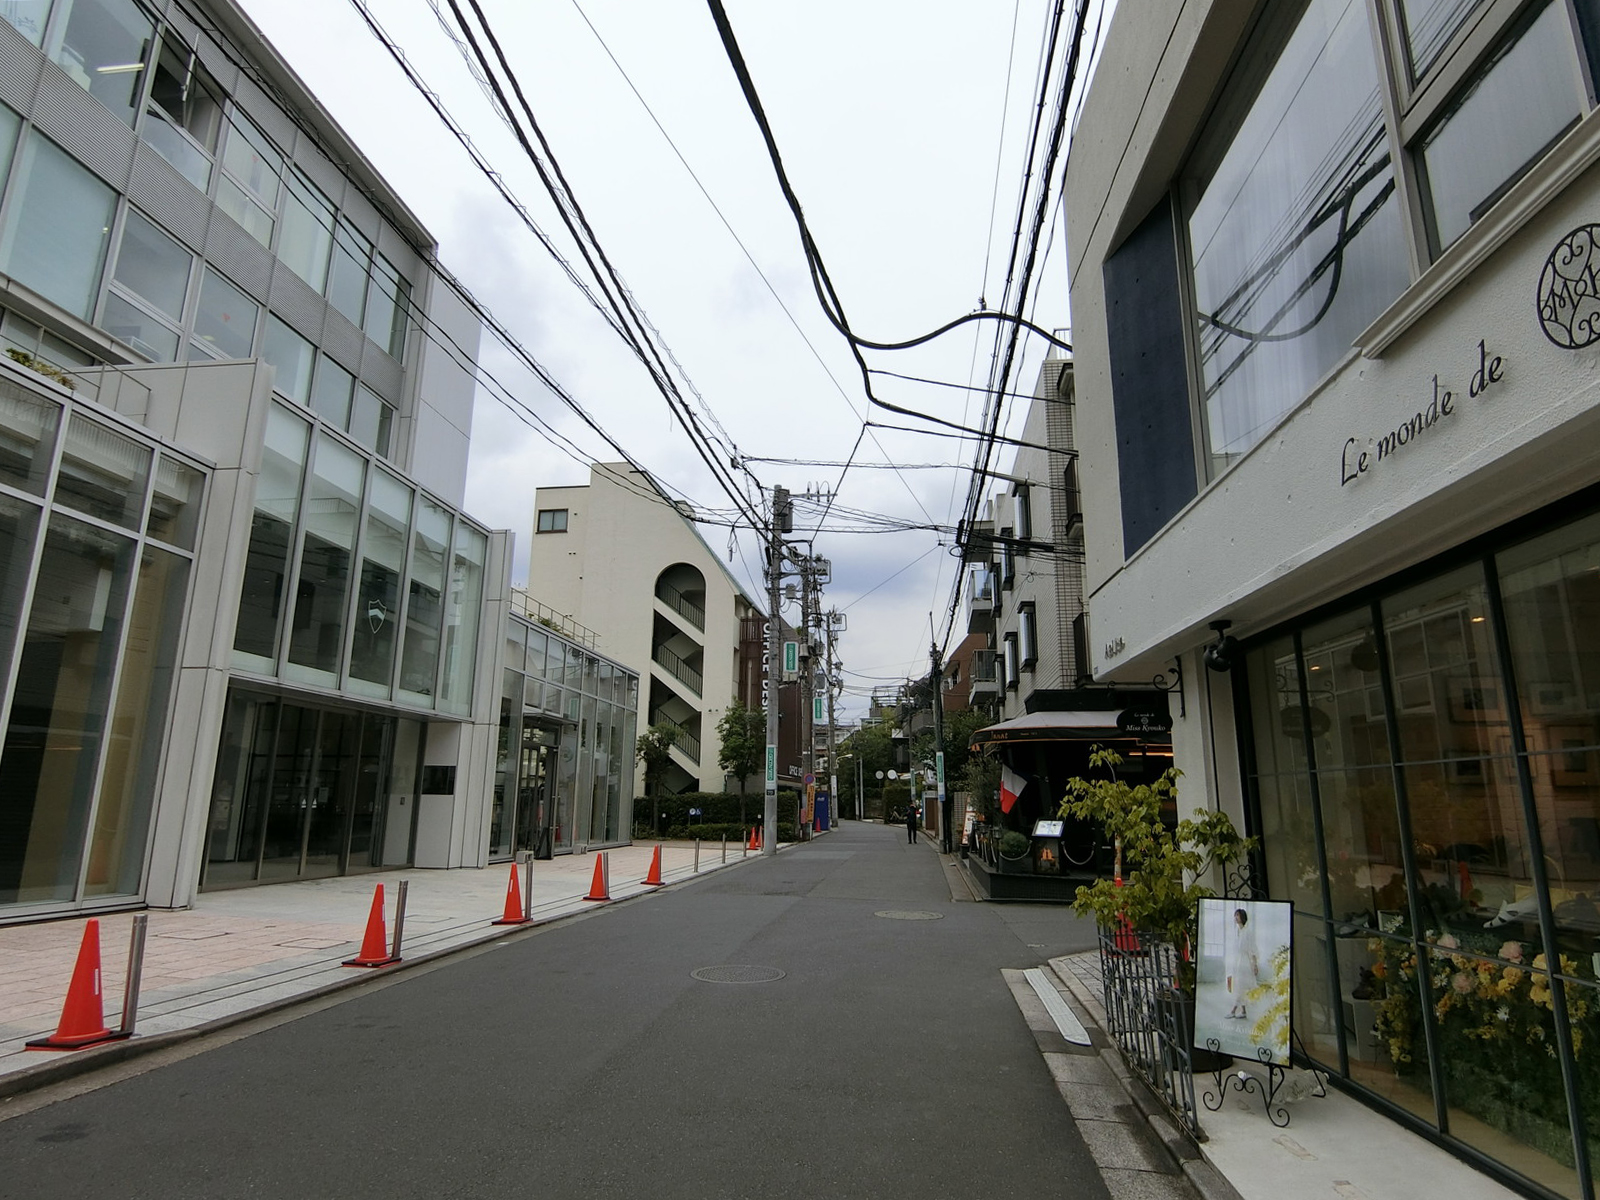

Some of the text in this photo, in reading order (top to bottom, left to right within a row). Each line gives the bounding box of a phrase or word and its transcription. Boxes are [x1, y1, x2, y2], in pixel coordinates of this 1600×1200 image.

[1341, 339, 1505, 487] Le monde de
[1125, 724, 1166, 733] Miss Kyouko
